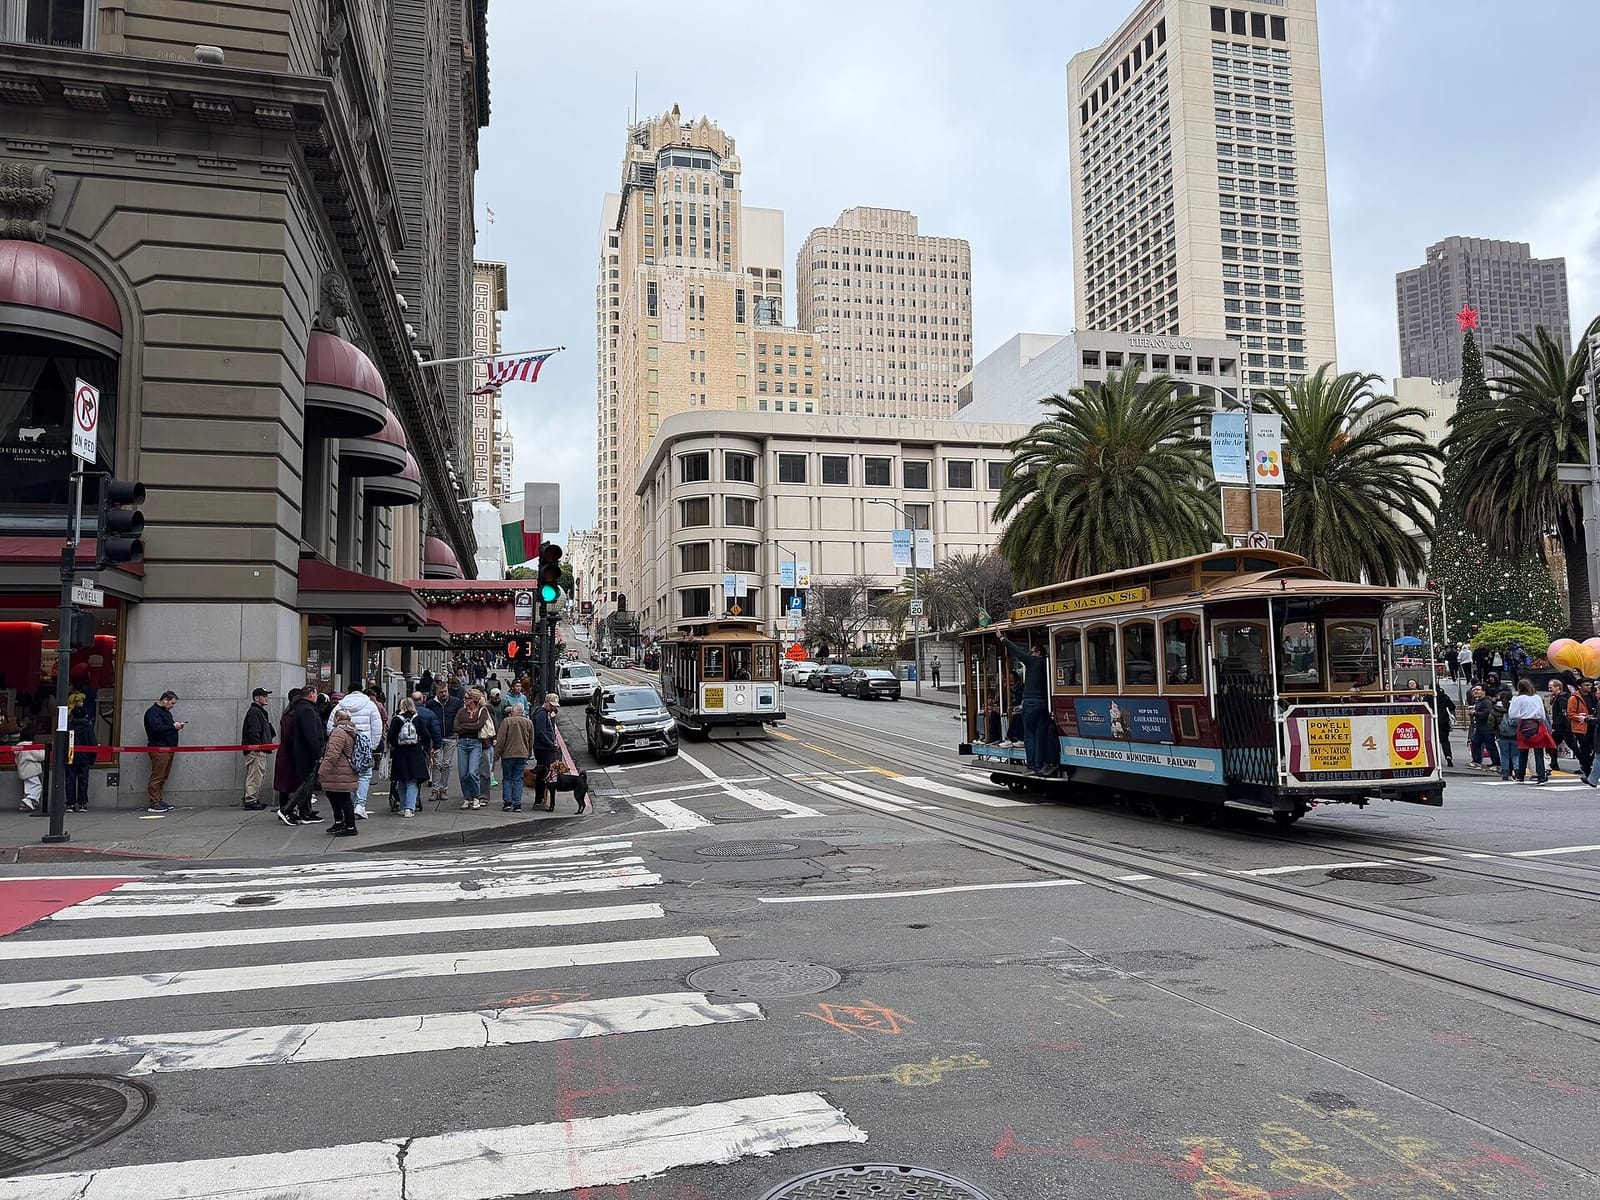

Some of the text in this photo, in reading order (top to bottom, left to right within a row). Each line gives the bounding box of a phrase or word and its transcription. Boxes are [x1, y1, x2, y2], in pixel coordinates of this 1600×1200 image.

[1129, 337, 1168, 348] TIFFANY
[1170, 340, 1176, 349] &
[807, 417, 1029, 440] SAKS FIFTH AVENU
[1213, 430, 1243, 438] Ambition
[74, 434, 94, 454] ON RED
[40, 447, 68, 456] STEAK
[475, 427, 488, 495] HOTEL
[78, 590, 98, 603] POWELL
[1020, 604, 1058, 617] POWELL
[1062, 602, 1069, 610] &
[1074, 594, 1116, 608] MASON
[526, 642, 532, 656] 3
[1308, 708, 1357, 718] MARKET
[1367, 706, 1408, 715] STREET
[1362, 736, 1376, 750] 4
[1076, 748, 1196, 768] SAN FRANCISCO MUNICIPAL RAILWAY
[1392, 768, 1424, 778] WHARF
